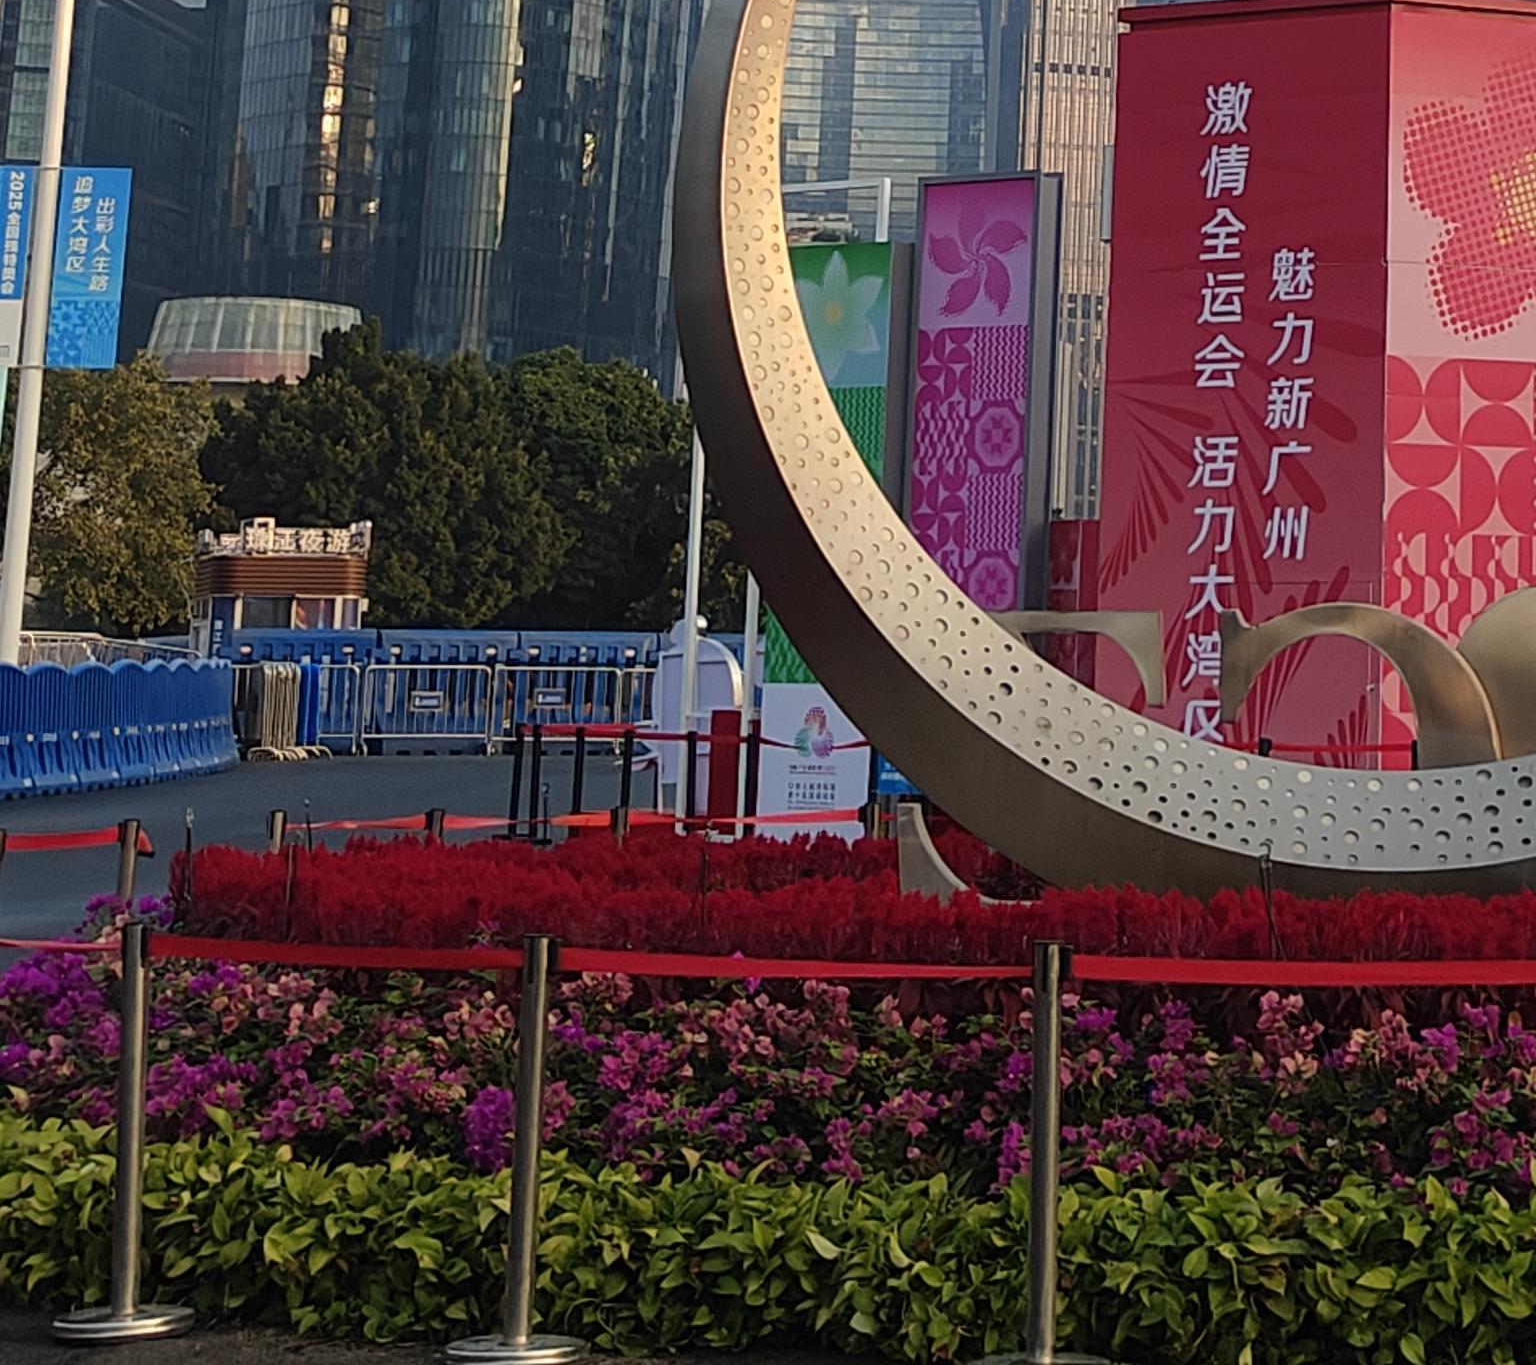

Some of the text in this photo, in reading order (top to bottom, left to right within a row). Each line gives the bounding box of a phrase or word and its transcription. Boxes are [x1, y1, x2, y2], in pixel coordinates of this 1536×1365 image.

[65, 175, 94, 273] 追梦大湾区
[88, 196, 116, 292] 出彩人生路
[1182, 80, 1252, 743] 激情全运会 活力大湾区
[1261, 247, 1317, 562] 魅力新广州
